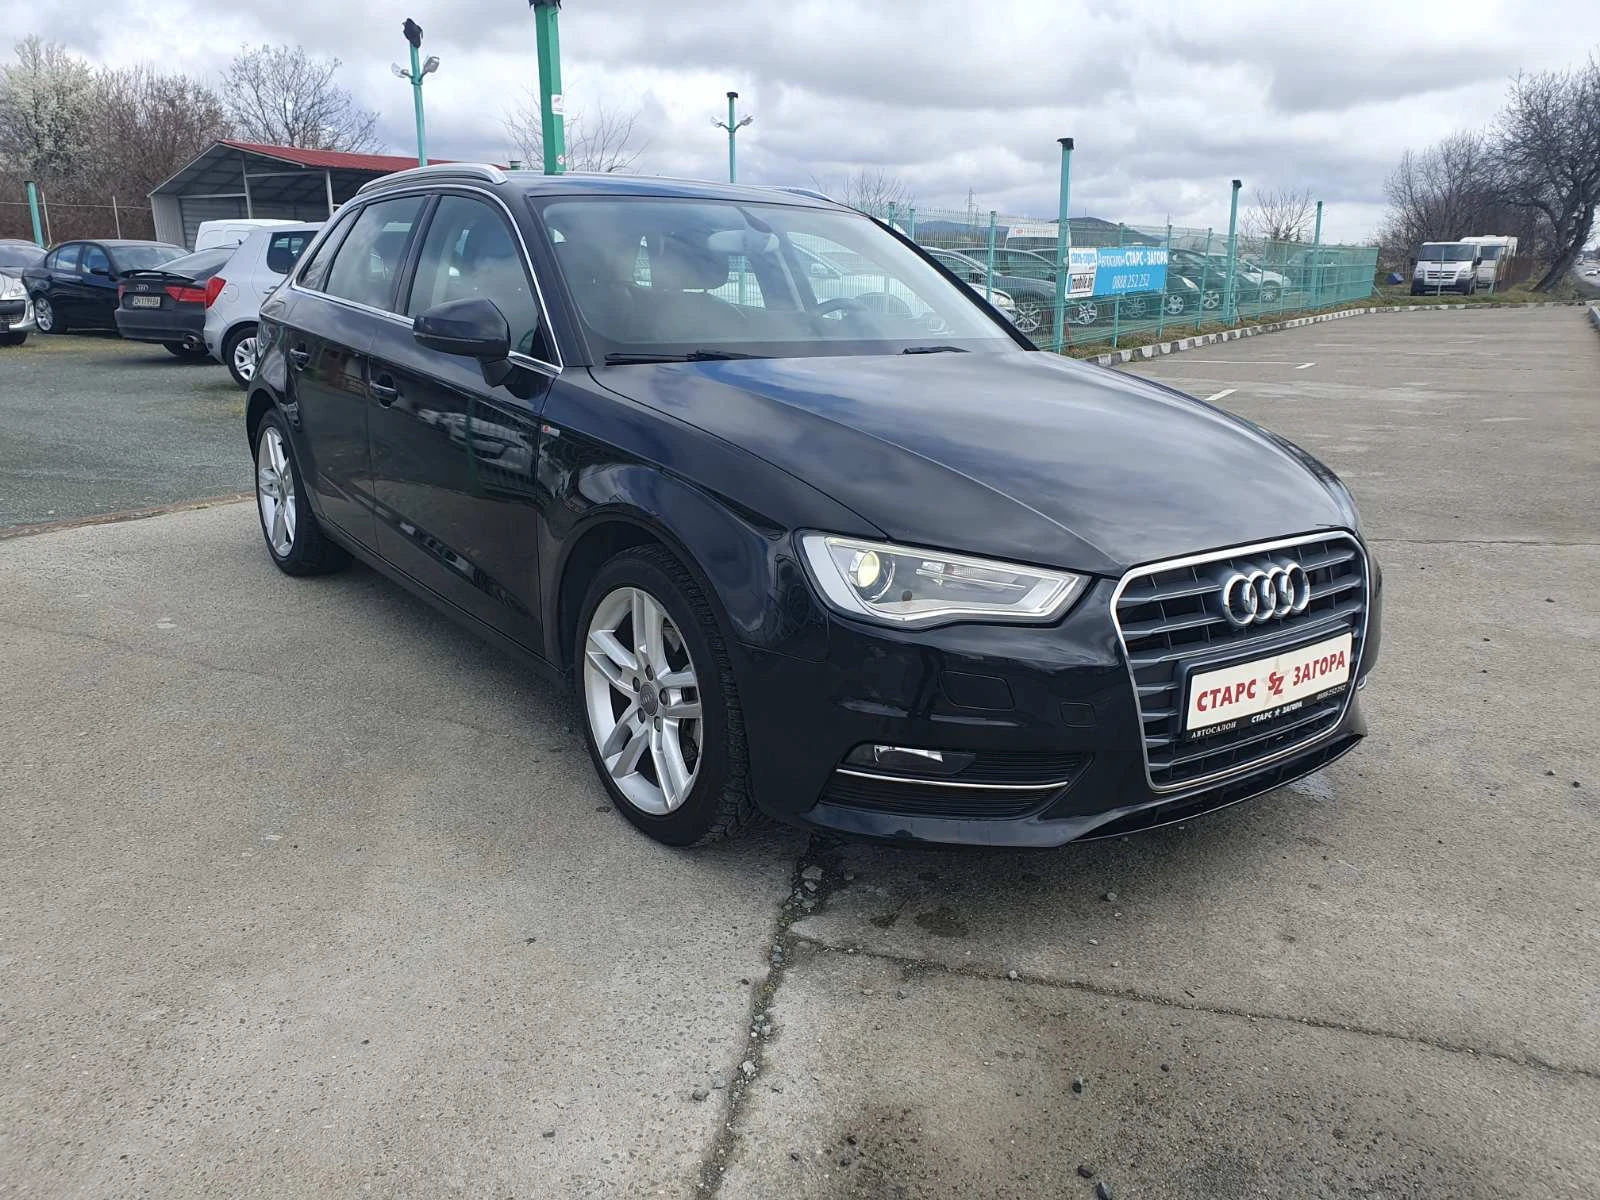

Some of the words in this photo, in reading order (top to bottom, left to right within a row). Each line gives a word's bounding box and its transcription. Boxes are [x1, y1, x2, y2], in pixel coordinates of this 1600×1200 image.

[1125, 250, 1144, 266] СТАРС
[1147, 250, 1168, 265] ЗАГОРА
[1128, 273, 1138, 288] 252
[1139, 273, 1150, 287] 252
[1196, 679, 1257, 712] СТАРС
[1293, 651, 1345, 686] ЗАГОРА
[1191, 721, 1237, 739] АВТОСАЛОН
[1251, 710, 1273, 723] СТАРС
[1282, 701, 1303, 714] ЗАГОРА
